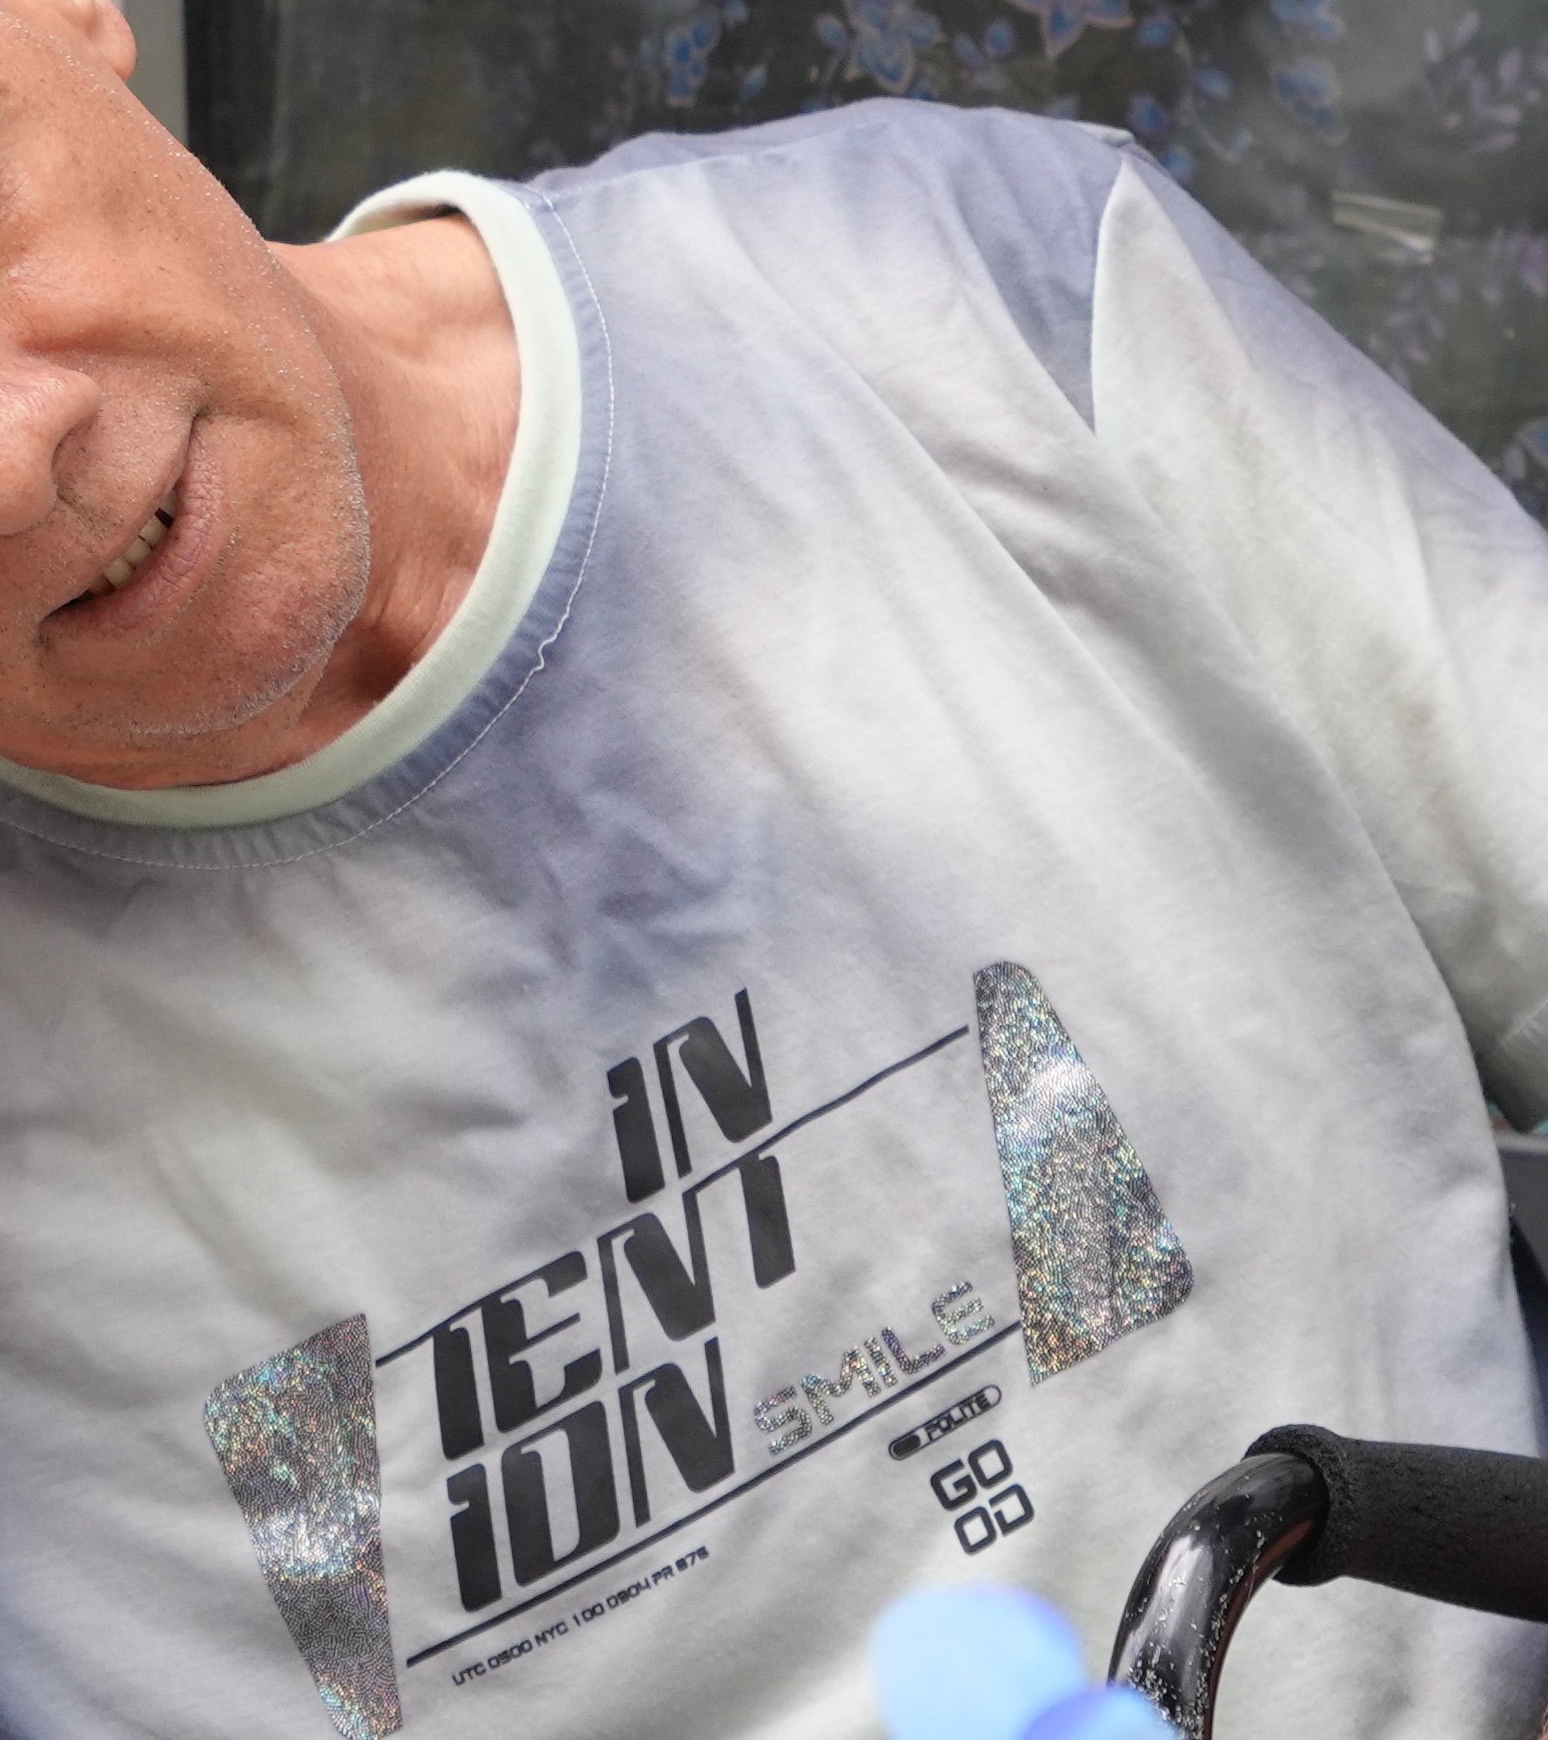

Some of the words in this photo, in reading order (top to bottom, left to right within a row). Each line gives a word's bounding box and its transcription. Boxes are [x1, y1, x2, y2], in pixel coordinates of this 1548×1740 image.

[753, 1280, 996, 1457] SMILE
[922, 1391, 993, 1444] POLITE
[451, 1661, 487, 1687] UTC
[534, 1621, 569, 1648] NYC
